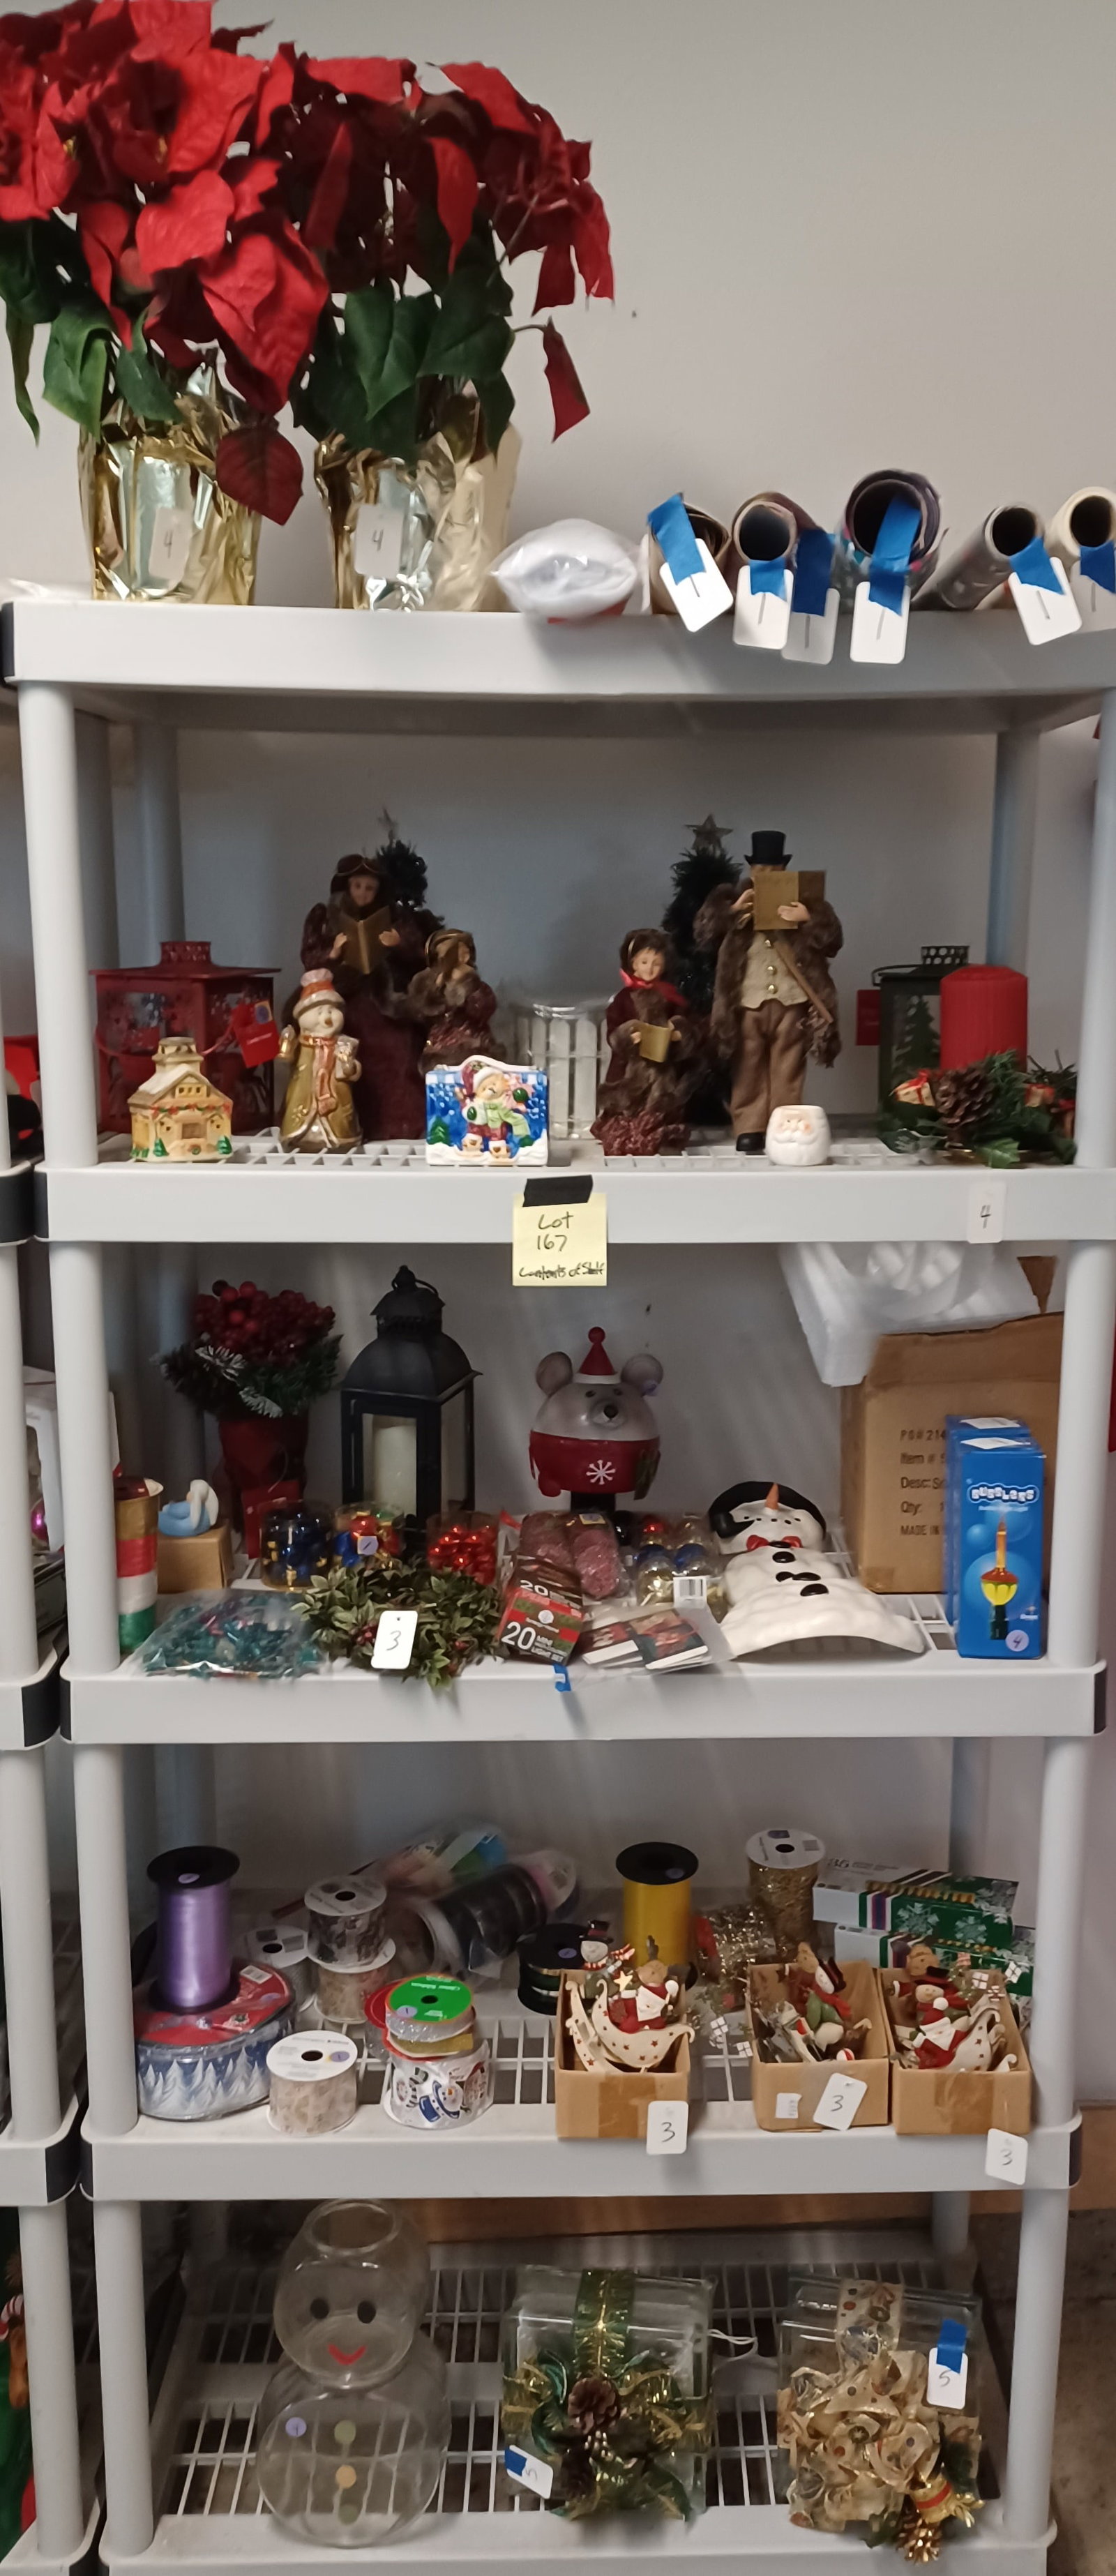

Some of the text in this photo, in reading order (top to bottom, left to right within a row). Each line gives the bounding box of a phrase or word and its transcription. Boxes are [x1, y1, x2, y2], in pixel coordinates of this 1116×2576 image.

[164, 530, 173, 559] 4
[372, 529, 384, 551] 4
[538, 1211, 573, 1230] Lot
[980, 1205, 991, 1229] 4
[537, 1233, 568, 1251] 167
[520, 1579, 549, 1596] 20
[386, 1629, 402, 1651] 3
[501, 1621, 536, 1650] 20
[1013, 1634, 1024, 1648] 4
[831, 2095, 844, 2111] 3
[661, 2121, 676, 2143] 3
[1000, 2149, 1013, 2166] 3
